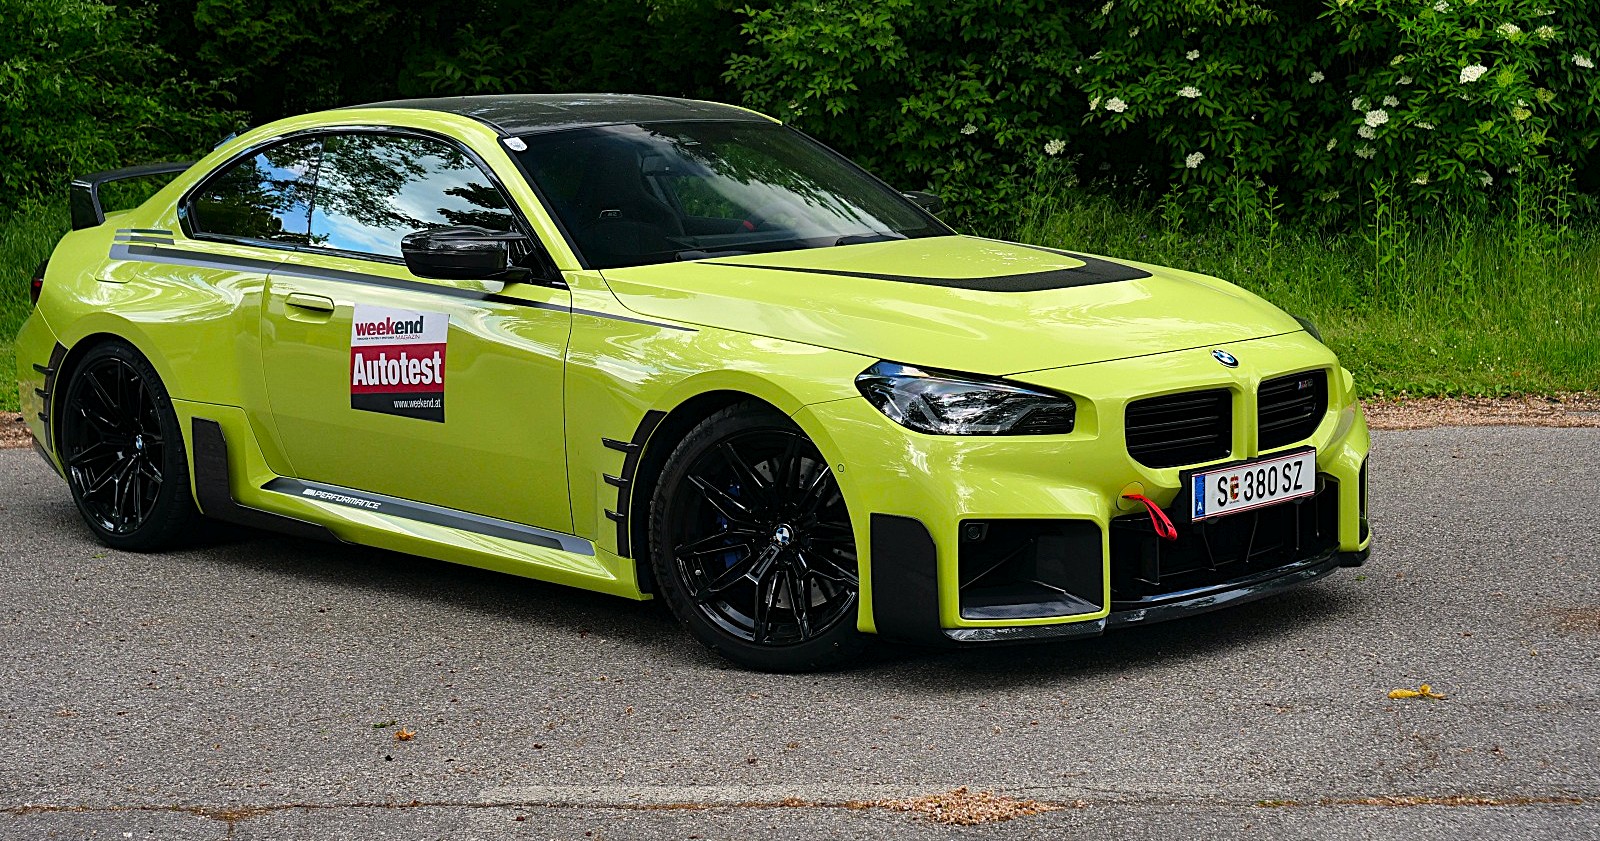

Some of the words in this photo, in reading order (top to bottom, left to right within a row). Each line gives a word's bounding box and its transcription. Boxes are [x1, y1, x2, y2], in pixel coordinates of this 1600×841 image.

[355, 315, 424, 336] weekend
[352, 350, 443, 386] Autotest
[393, 397, 442, 409] www.weekend.at
[1217, 475, 1228, 507] S
[1243, 465, 1278, 502] 380
[1282, 460, 1303, 493] SZ
[314, 490, 382, 510] PERFORMANCE
[1196, 501, 1203, 512] A
